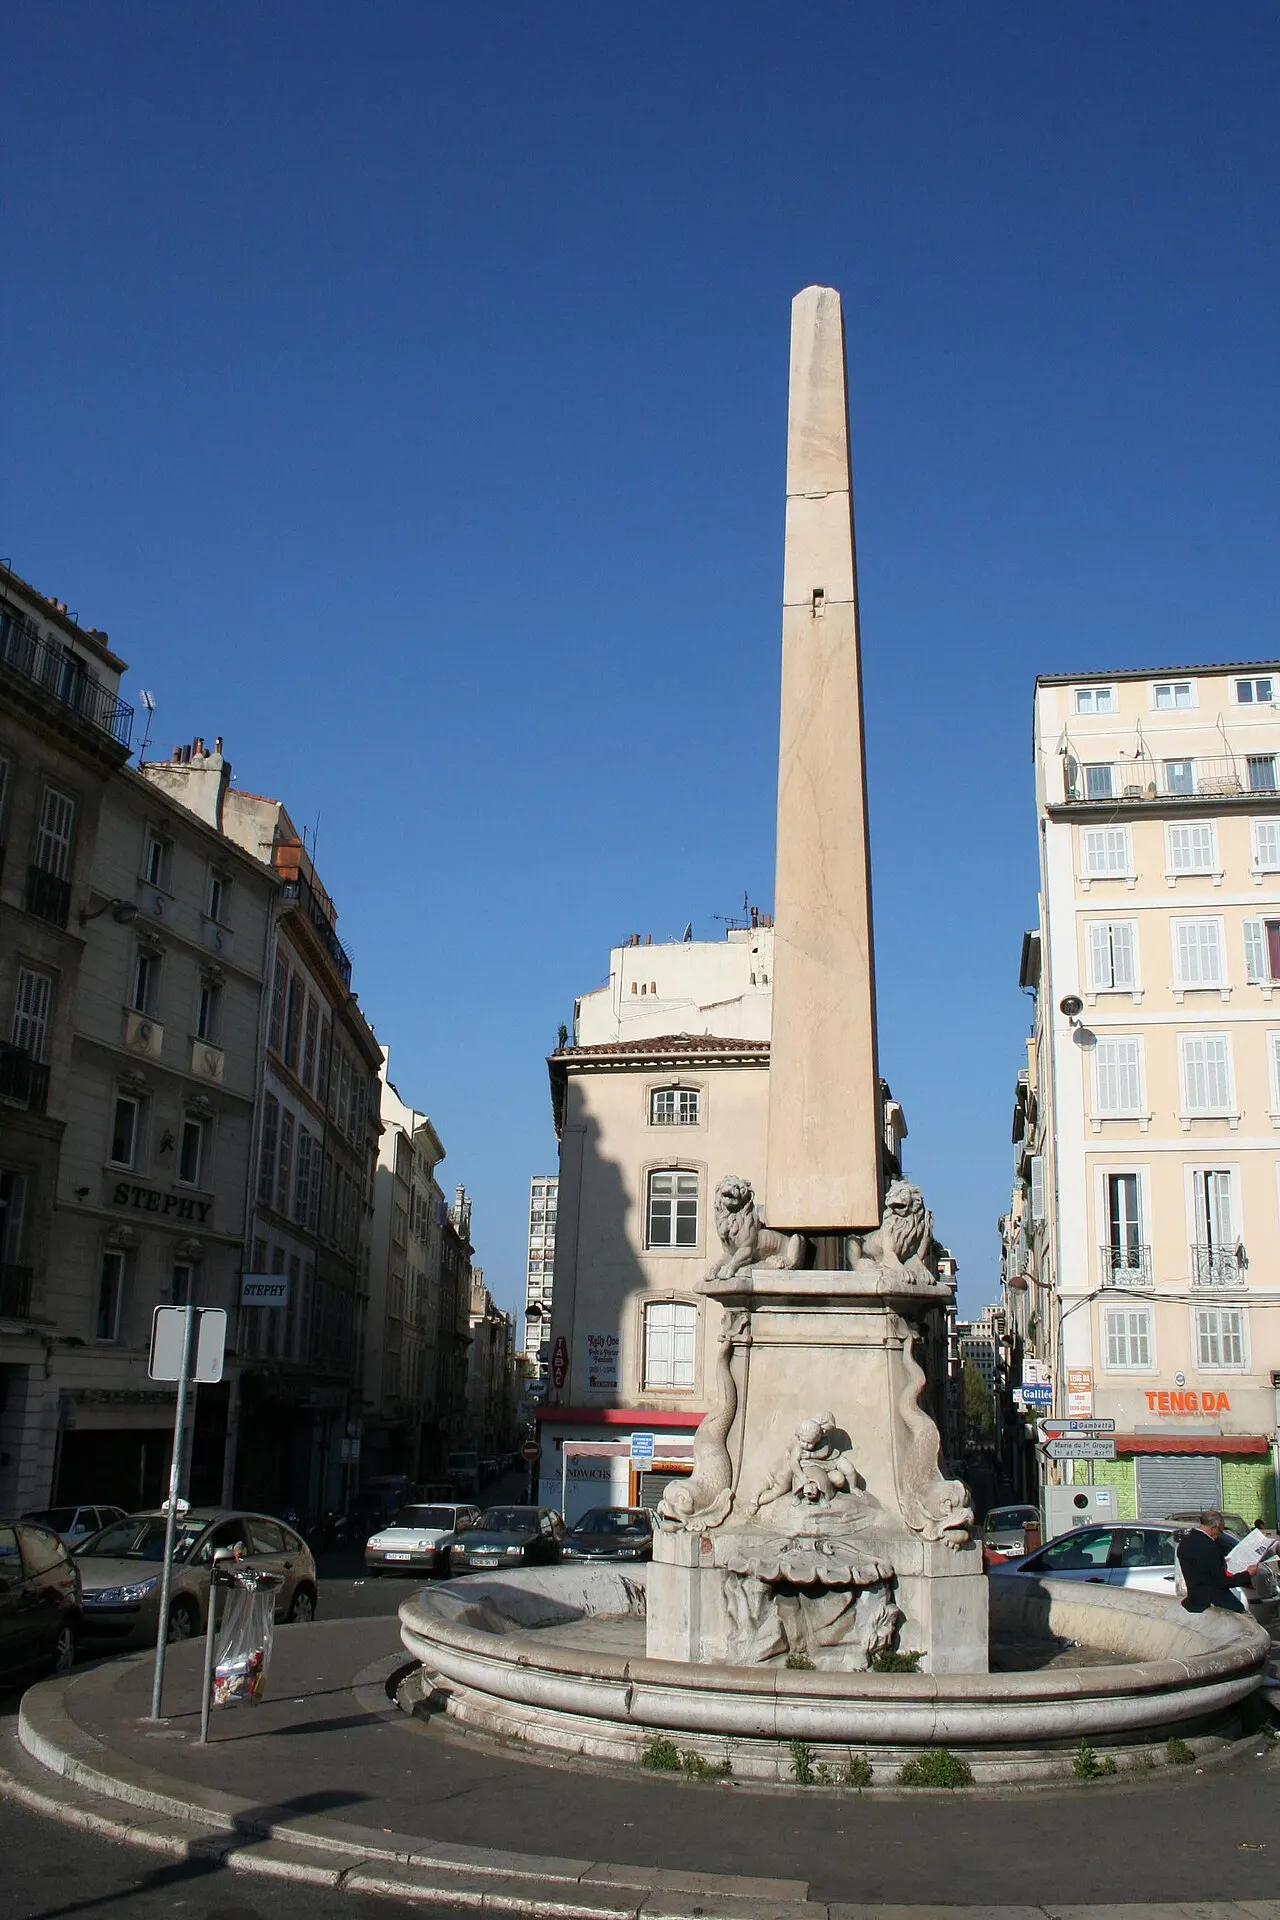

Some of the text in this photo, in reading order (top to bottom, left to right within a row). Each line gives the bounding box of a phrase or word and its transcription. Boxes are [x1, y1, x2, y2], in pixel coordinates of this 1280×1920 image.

[113, 1182, 213, 1223] STEPHY
[243, 1283, 286, 1297] STEPHY
[606, 1334, 620, 1347] One
[554, 1339, 564, 1385] TABAC
[1144, 1391, 1231, 1411] TENG DA
[556, 1469, 611, 1480] SNDWICHS
